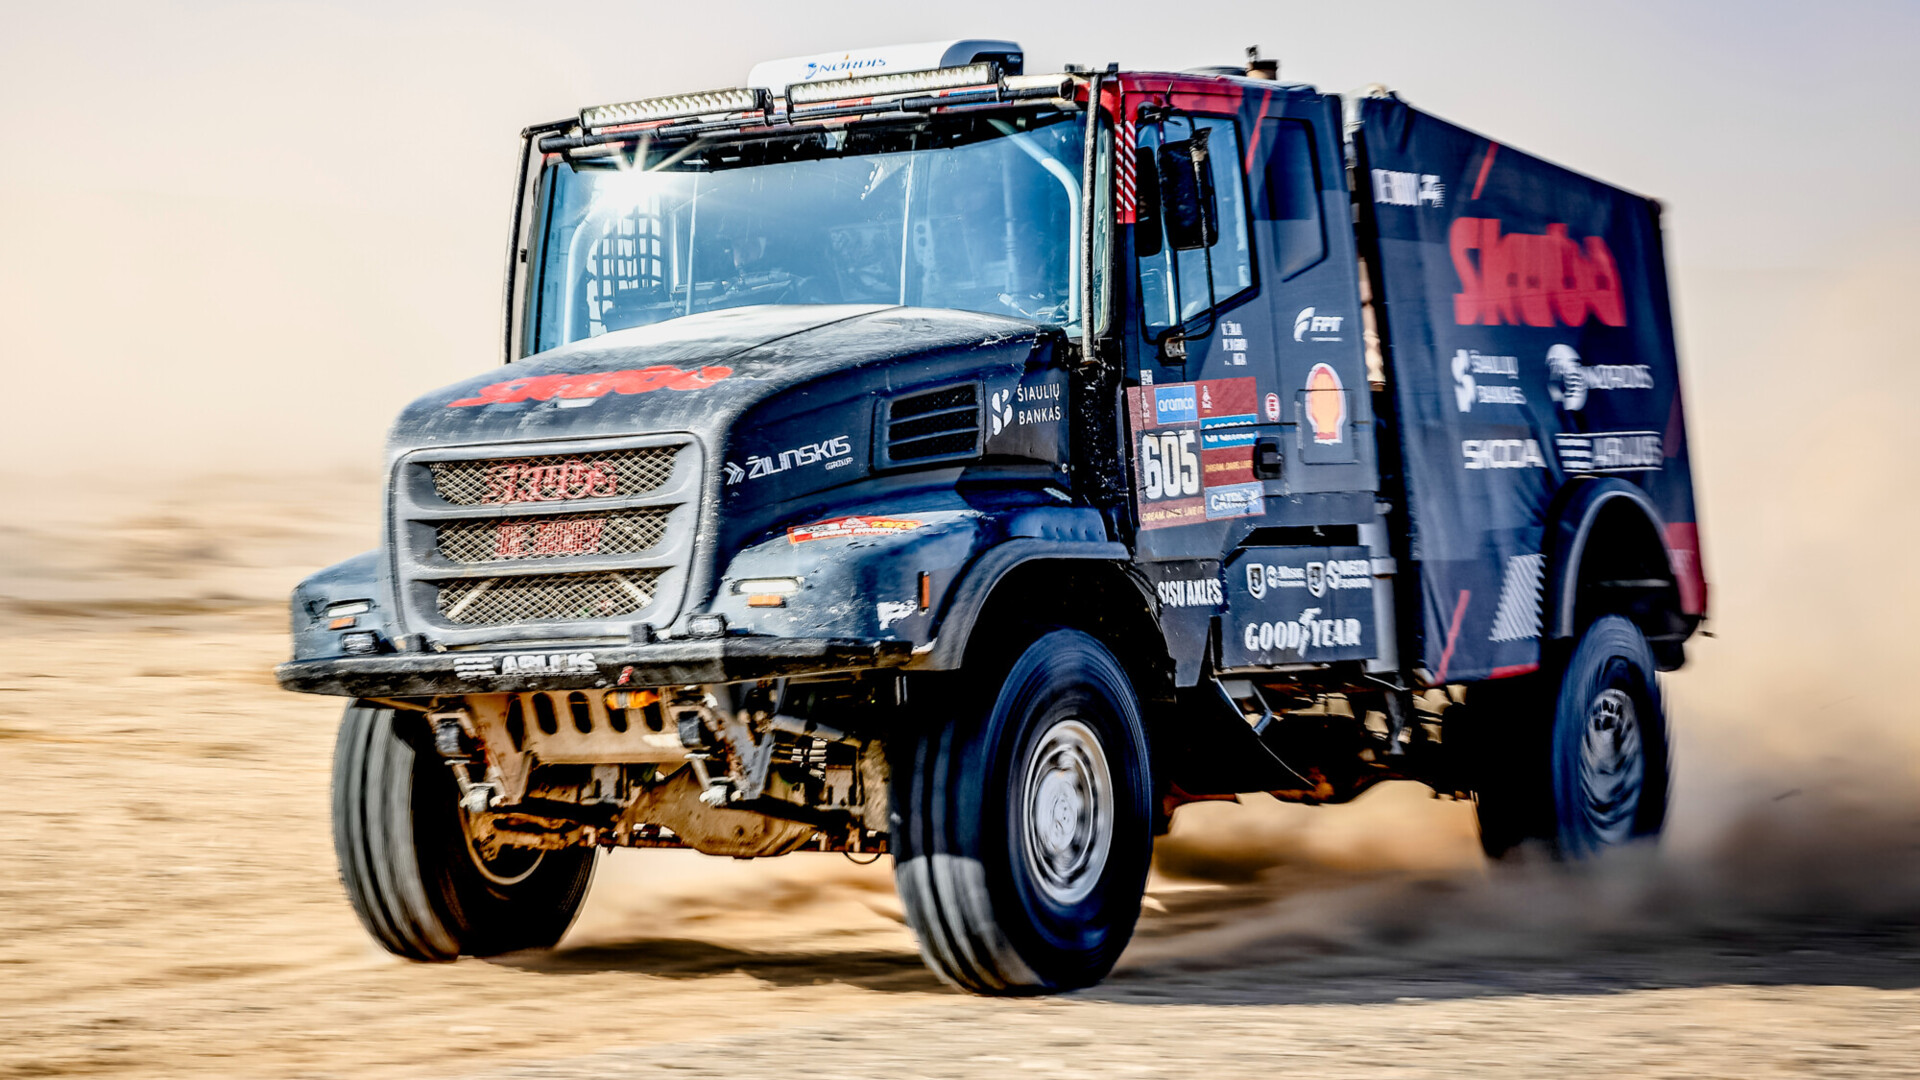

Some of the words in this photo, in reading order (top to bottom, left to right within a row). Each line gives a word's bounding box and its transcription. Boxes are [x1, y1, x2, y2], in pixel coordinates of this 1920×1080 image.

[1017, 383, 1060, 402] ŠIAULIŲ
[1158, 397, 1195, 412] aramco
[1018, 405, 1061, 425] BANKAS
[745, 435, 851, 479] ŽILINSKIS
[825, 457, 853, 470] GROUP
[1142, 429, 1200, 500] 605
[1157, 580, 1185, 609] SISU
[1245, 611, 1362, 655] GOODYEAR
